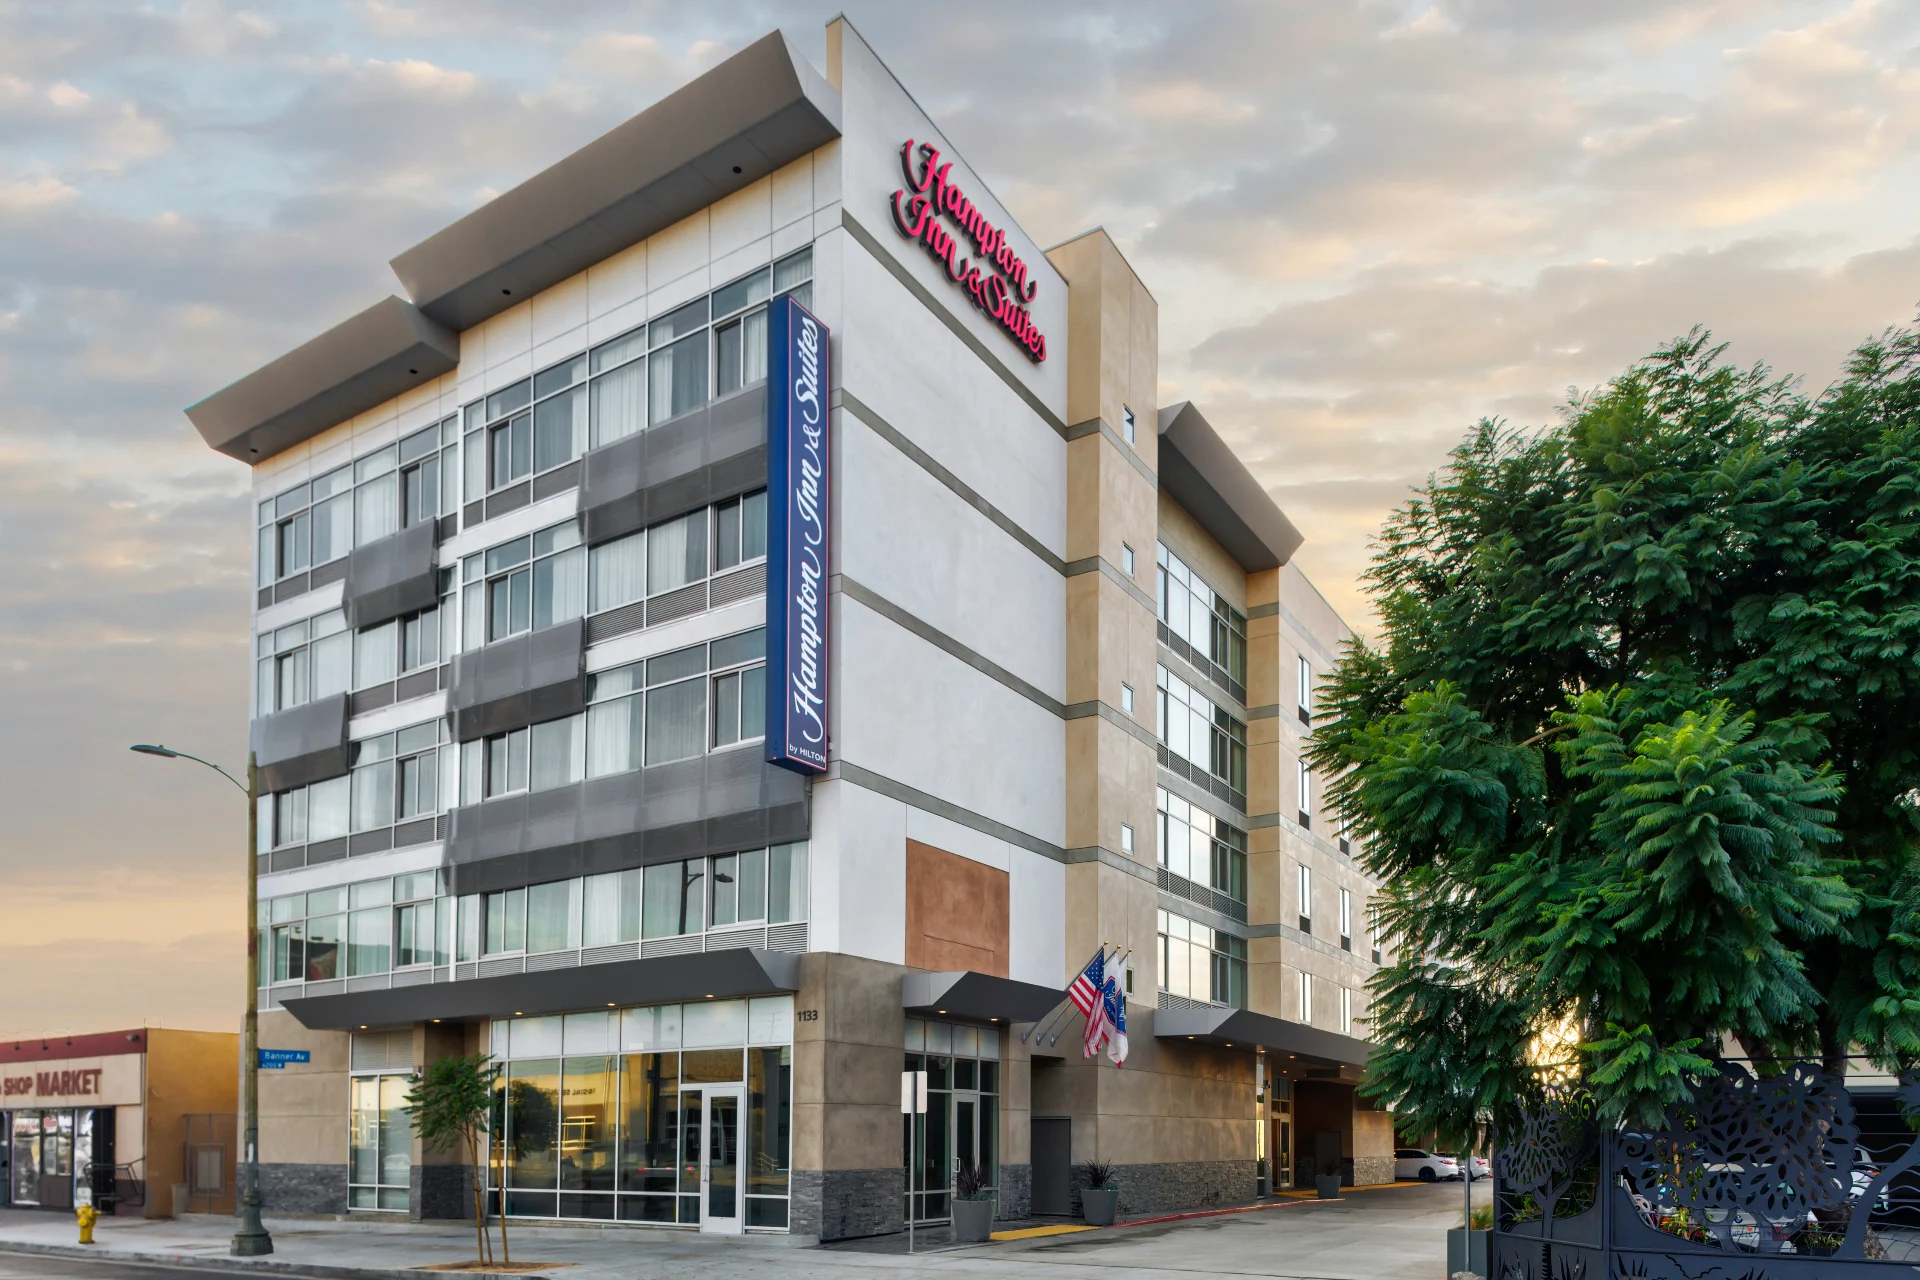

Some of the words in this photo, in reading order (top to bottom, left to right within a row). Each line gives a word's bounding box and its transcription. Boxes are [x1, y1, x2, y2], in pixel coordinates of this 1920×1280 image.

[900, 138, 1037, 304] Hampton
[890, 189, 969, 284] Inn
[982, 273, 1047, 364] Suites
[795, 316, 819, 424] Suites
[802, 424, 821, 449] &
[796, 443, 822, 545] Inn
[792, 546, 824, 743] Hampton
[789, 743, 798, 754] by
[799, 746, 826, 763] HILTON
[797, 1009, 818, 1022] 1133
[4, 1076, 33, 1096] SHOP
[36, 1068, 103, 1097] MARKET
[264, 1051, 294, 1060] Banner
[296, 1052, 306, 1061] Av
